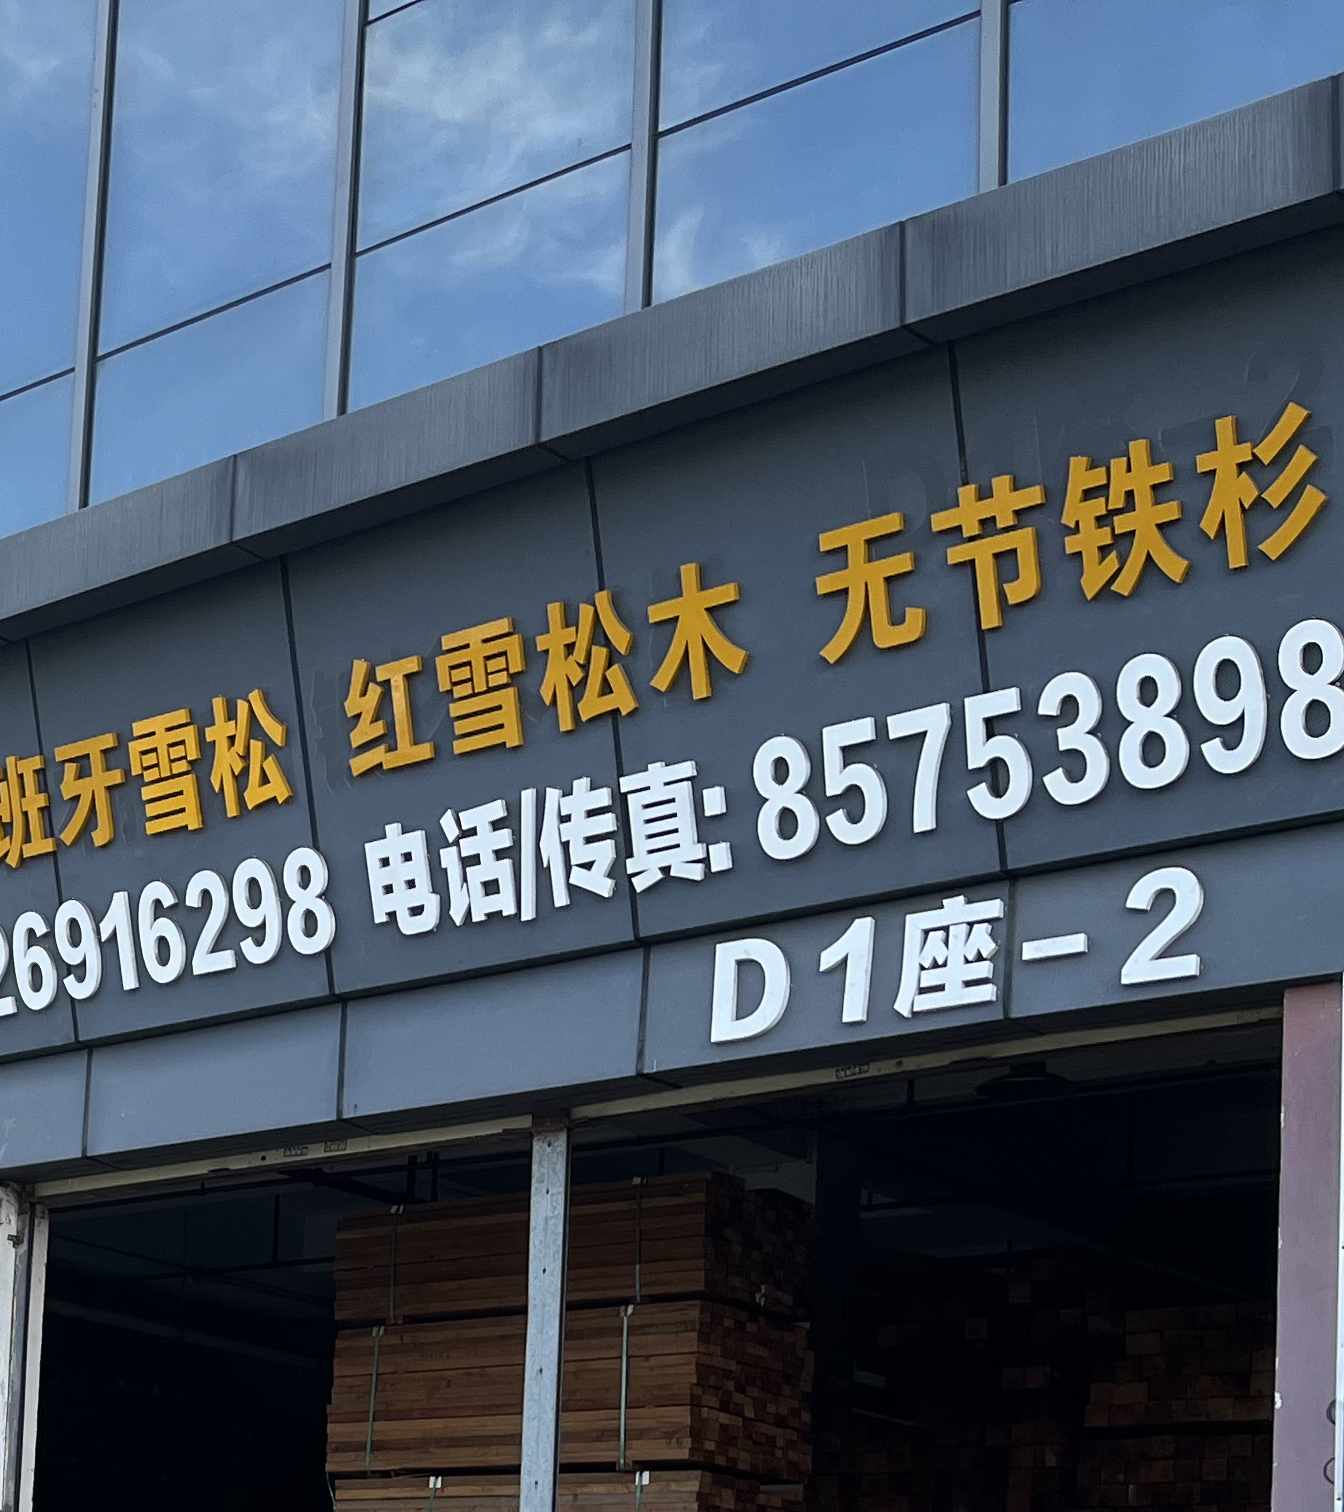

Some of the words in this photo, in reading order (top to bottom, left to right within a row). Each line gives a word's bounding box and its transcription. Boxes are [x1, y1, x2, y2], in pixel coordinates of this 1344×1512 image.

[816, 402, 1329, 666] 无节铁杉
[343, 561, 749, 779] 红雪松木
